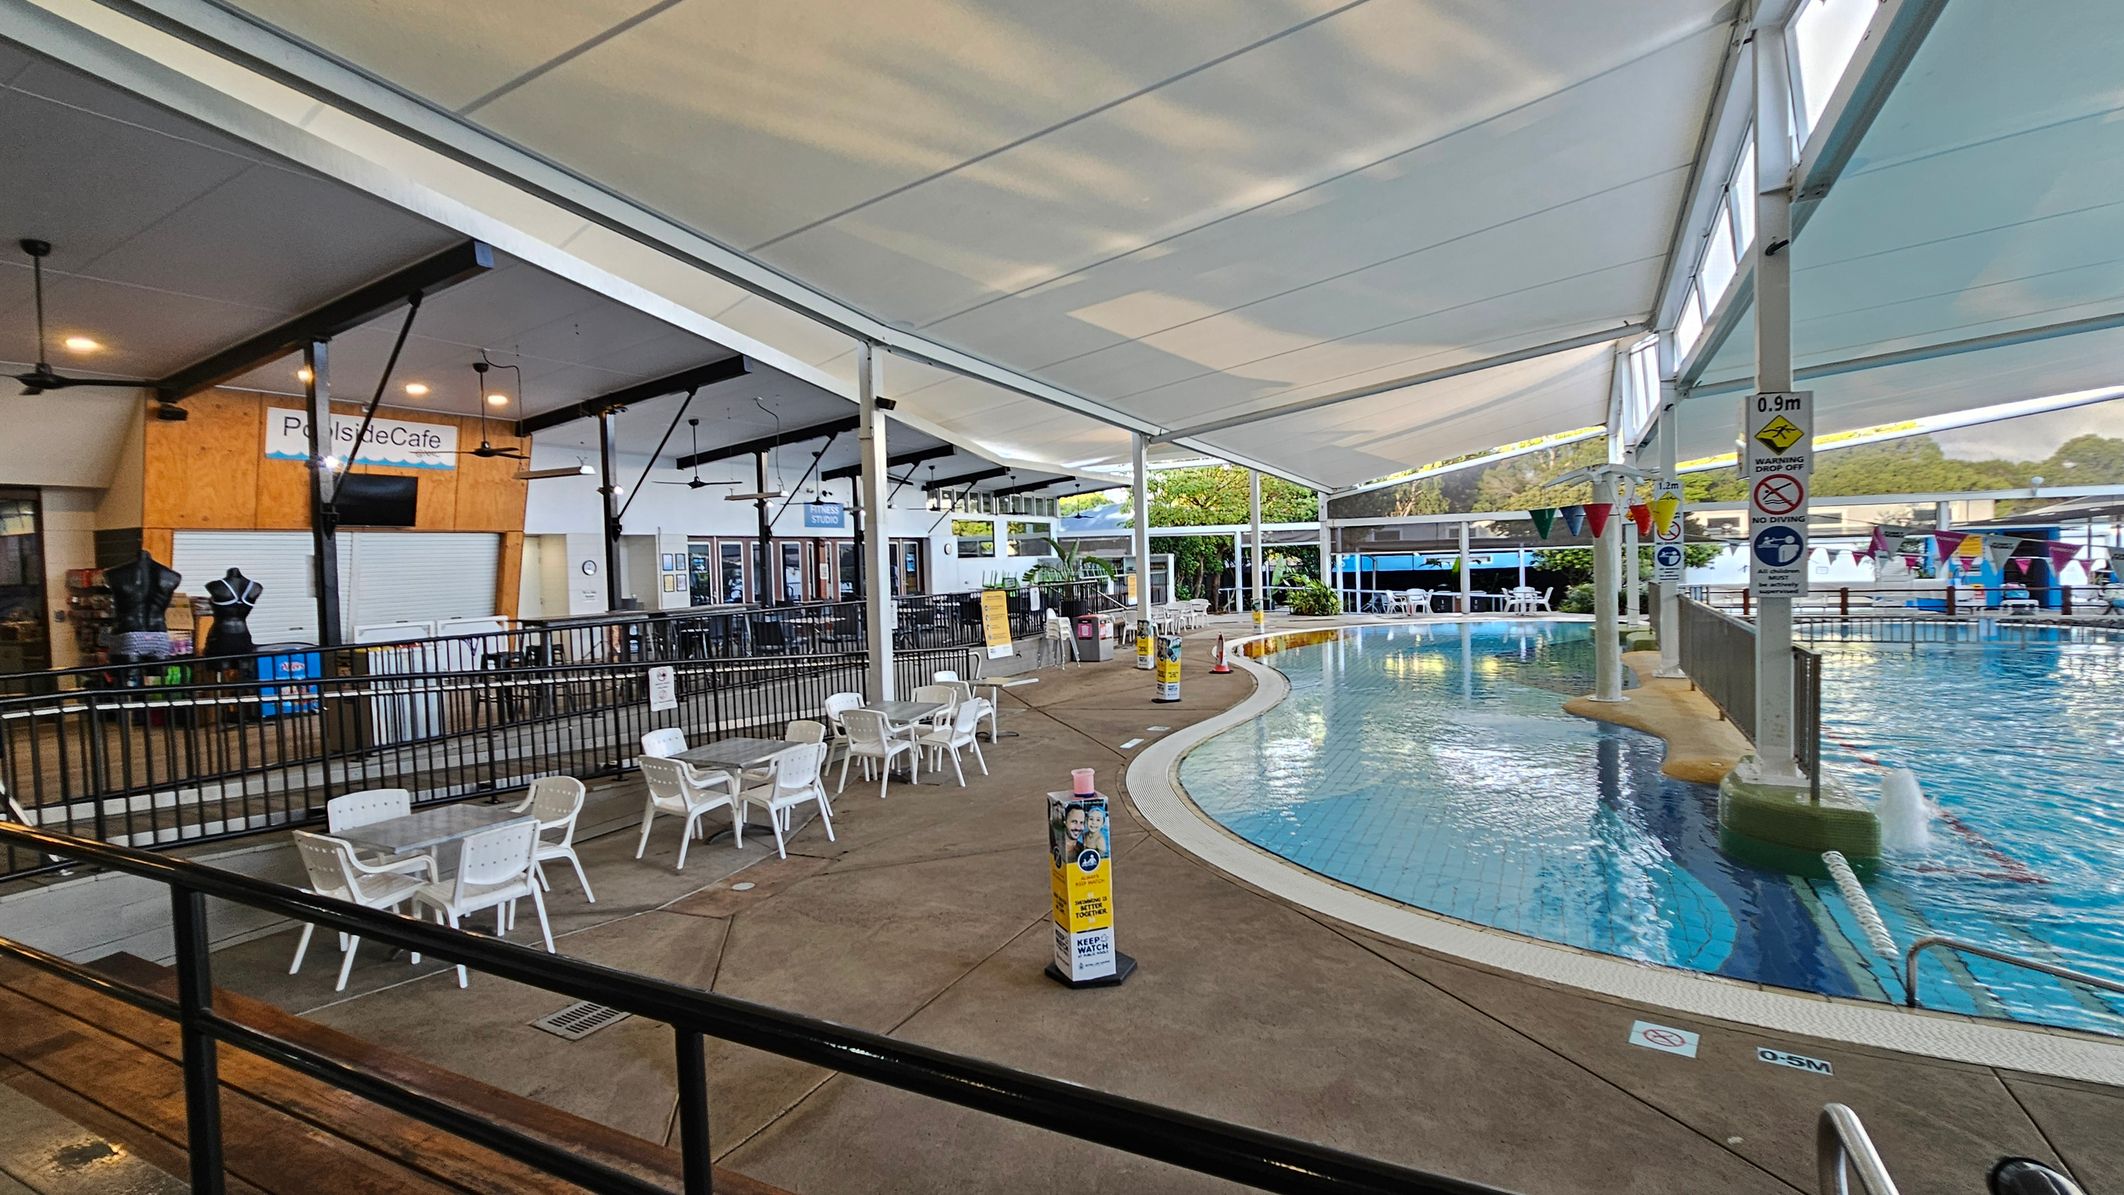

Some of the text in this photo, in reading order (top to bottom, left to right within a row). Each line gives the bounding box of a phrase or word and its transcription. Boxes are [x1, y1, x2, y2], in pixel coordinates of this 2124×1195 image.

[1757, 395, 1801, 412] 0.9m
[283, 416, 442, 449] PlsideCafe
[1755, 456, 1804, 465] WARNING
[1659, 482, 1679, 490] 1.2m
[810, 504, 840, 514] FITNESS
[811, 515, 839, 524] STUDIO
[1081, 903, 1102, 911] BETTER
[1075, 908, 1108, 918] TOGETHER
[1077, 936, 1100, 946] KEEP
[1077, 943, 1109, 954] WATCH
